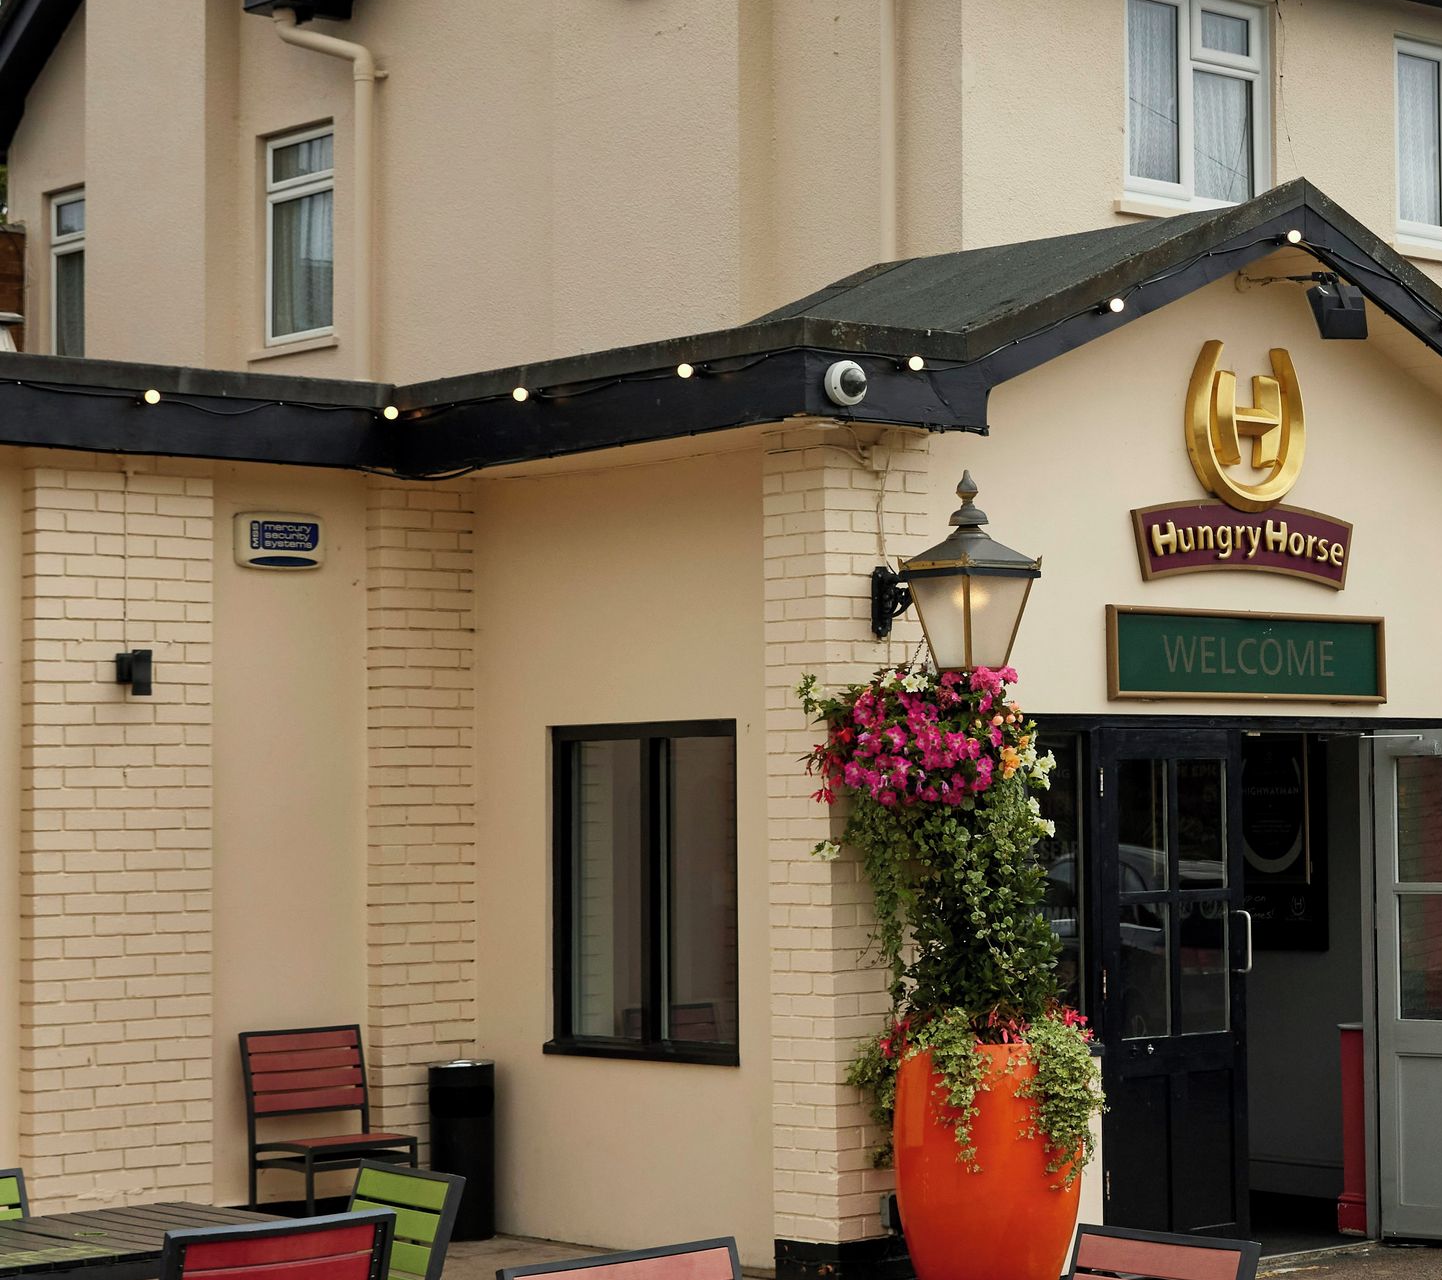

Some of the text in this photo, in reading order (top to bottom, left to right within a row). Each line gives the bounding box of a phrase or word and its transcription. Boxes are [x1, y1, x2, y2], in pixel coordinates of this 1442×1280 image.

[264, 523, 312, 534] mercury
[264, 532, 311, 542] security
[264, 540, 313, 549] systems
[1162, 634, 1335, 677] WELCOME
